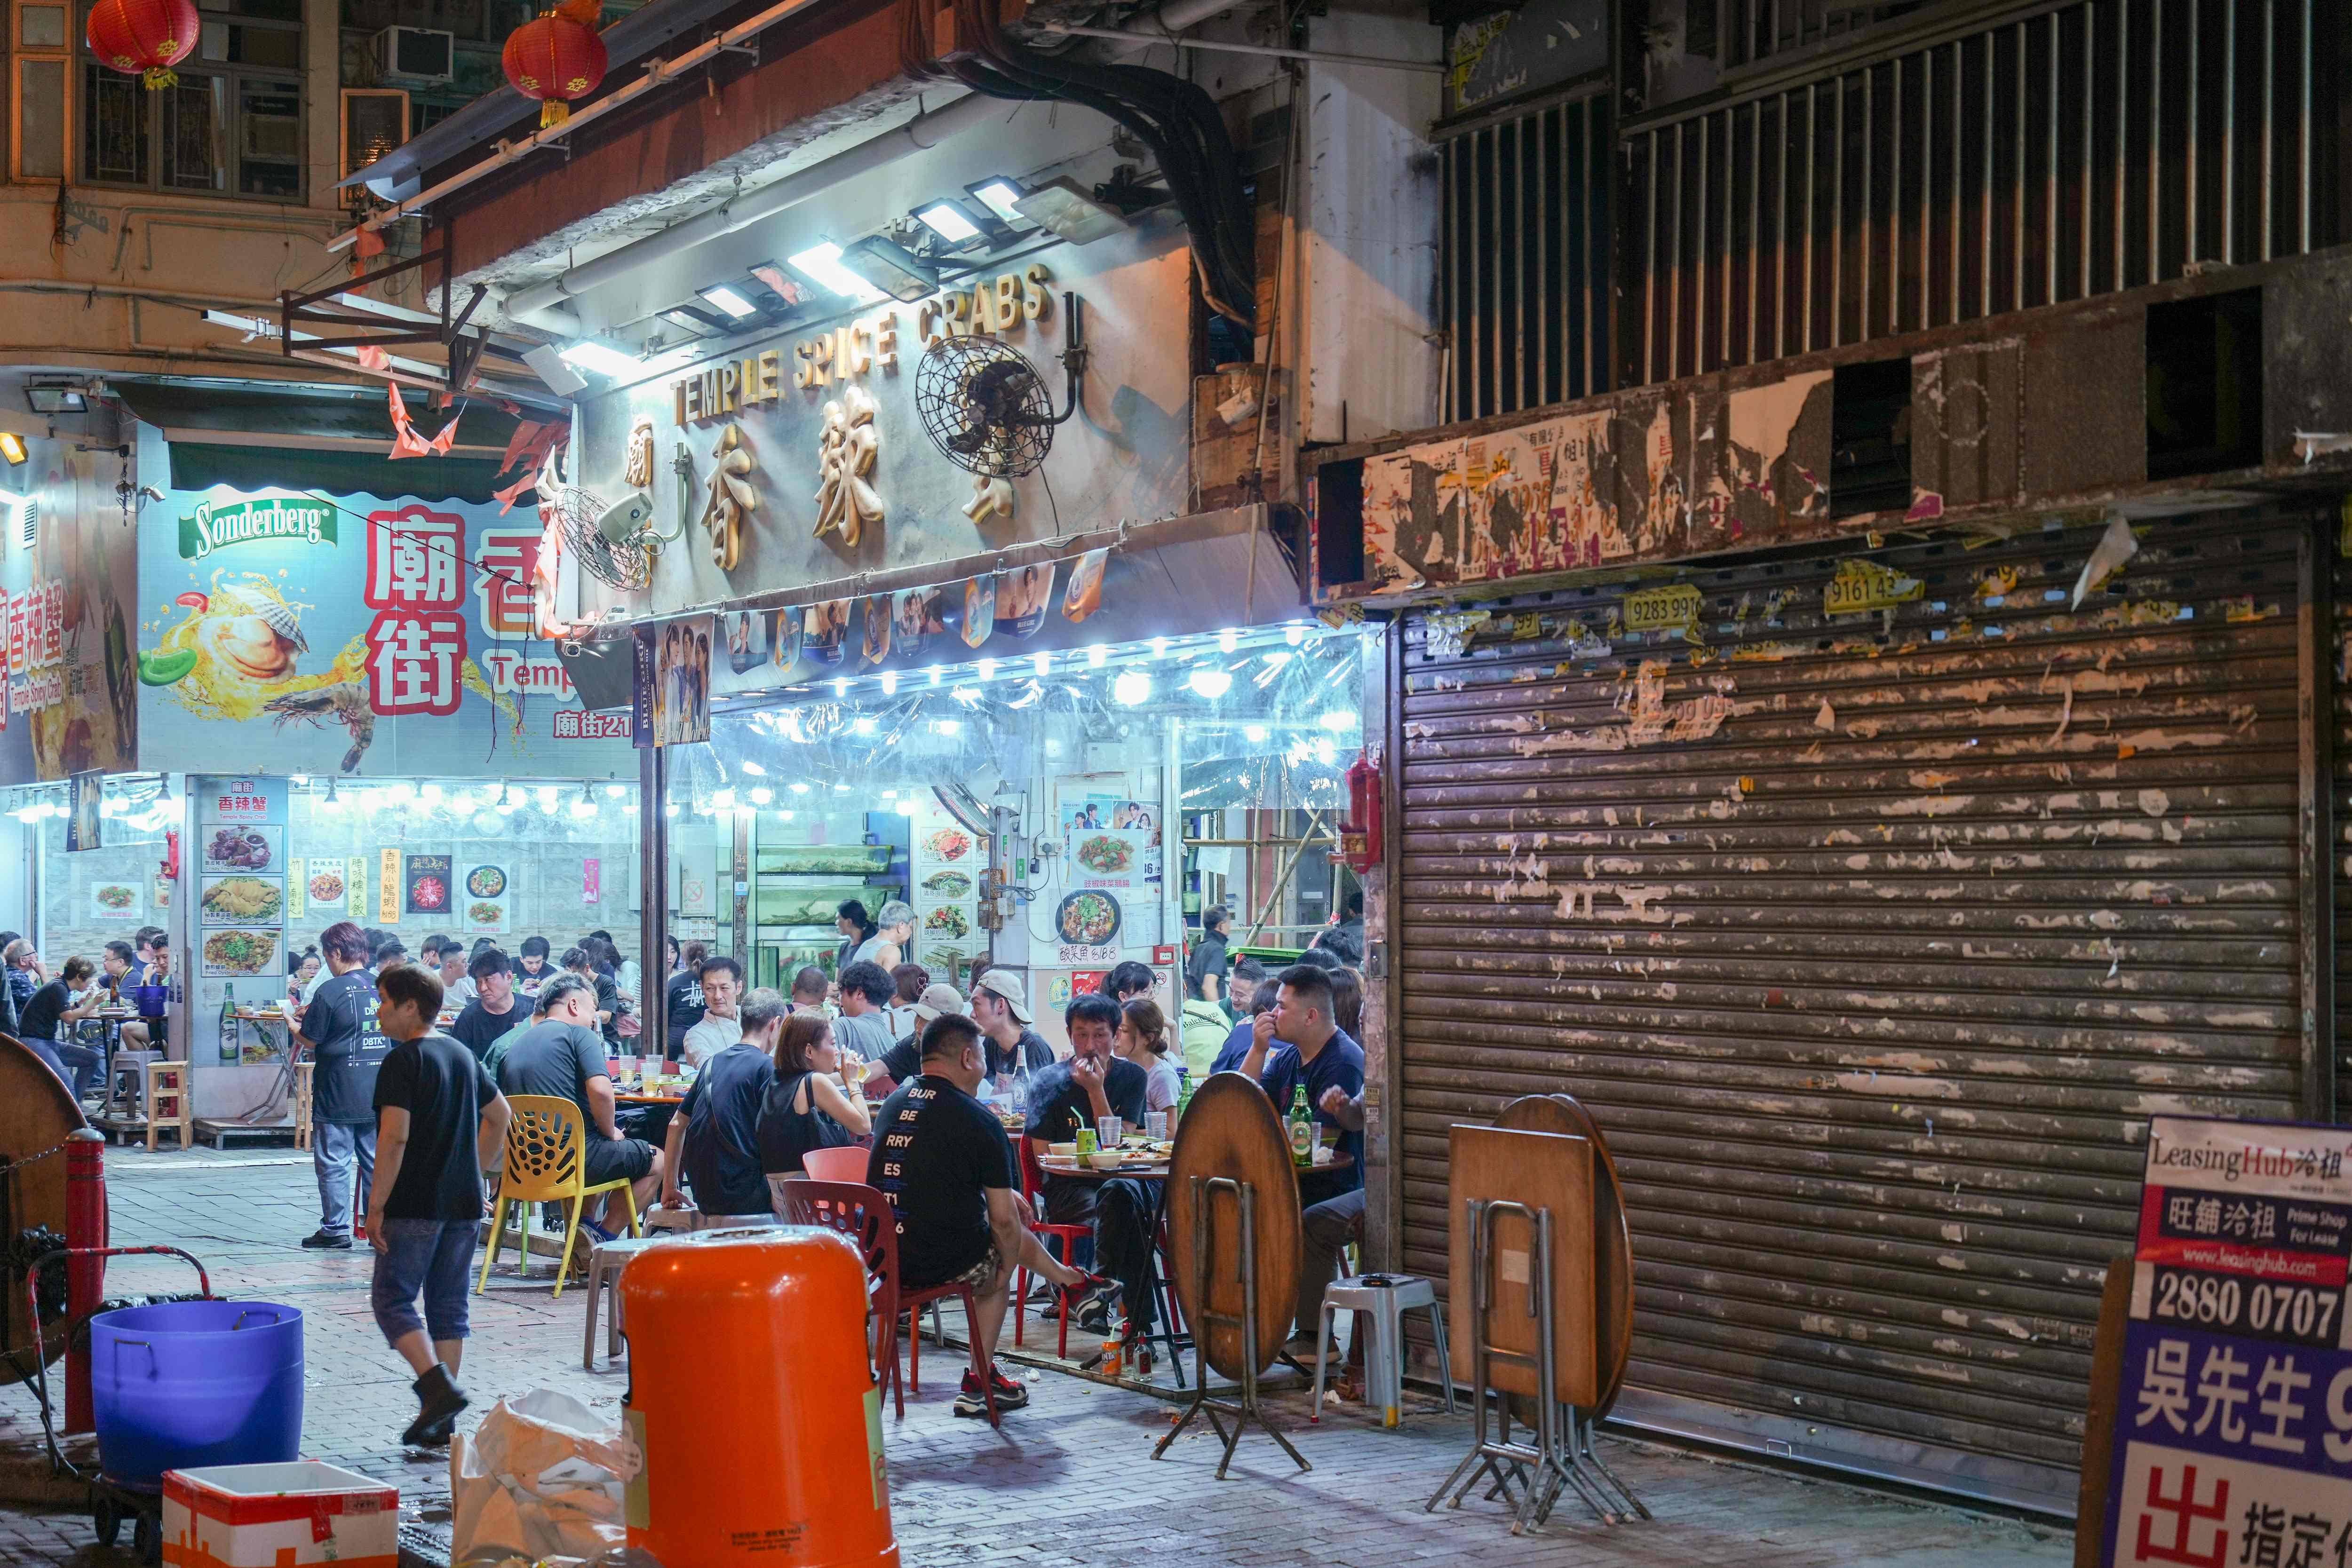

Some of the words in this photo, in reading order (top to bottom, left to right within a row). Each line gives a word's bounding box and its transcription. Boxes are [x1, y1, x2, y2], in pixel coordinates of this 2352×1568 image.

[670, 349, 779, 426] TEMPLE
[794, 312, 898, 390] SPICE
[918, 263, 1049, 351] CRABS
[195, 497, 324, 560] Sonderberg
[1832, 578, 1870, 602] 9161
[373, 514, 458, 706] 廟街
[1634, 599, 1668, 621] 9283
[10, 584, 63, 670] 香辣蟹
[11, 685, 29, 705] Temple
[31, 682, 46, 705] Spicy
[48, 679, 61, 699] Crab
[232, 782, 254, 792] 廟街
[219, 796, 267, 812] 香辣蟹
[382, 849, 397, 909] 香辣小龍蝦
[1084, 880, 1130, 888] 豉椒味菜鵝腸
[1060, 945, 1089, 963] 酸菜魚
[1183, 1012, 1219, 1028] Baleniaga
[363, 1037, 383, 1046] DBTK
[908, 1088, 937, 1100] BUR
[899, 1110, 919, 1121] BE
[886, 1135, 913, 1148] RRY
[884, 1163, 901, 1176] ES
[884, 1193, 898, 1206] T1
[896, 1222, 904, 1234] 6
[2287, 1207, 2318, 1224] Prime
[2319, 1211, 2347, 1230] Shop
[2290, 1227, 2308, 1243] For
[2309, 1230, 2339, 1247] Lease
[2183, 1247, 2316, 1276] www.leasinghub.com
[2157, 1272, 2241, 1326] 2880
[2250, 1283, 2338, 1339] 0707
[2136, 1338, 2312, 1454] 吳先生
